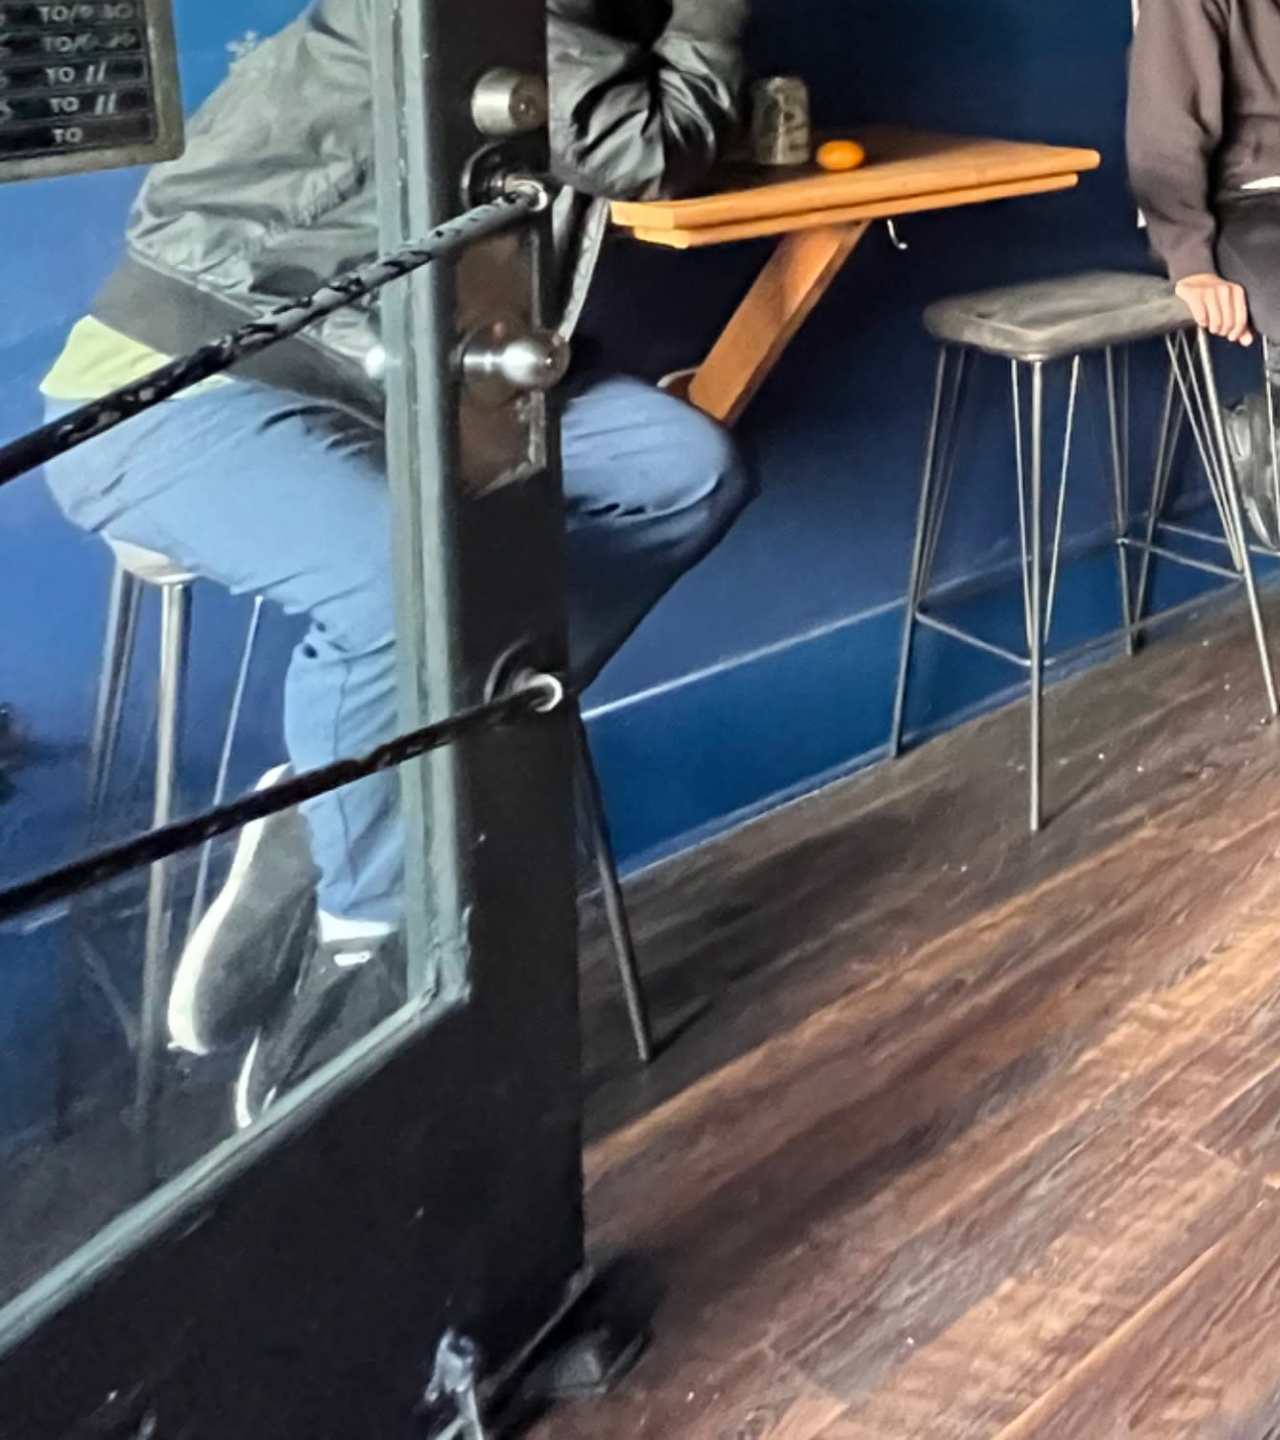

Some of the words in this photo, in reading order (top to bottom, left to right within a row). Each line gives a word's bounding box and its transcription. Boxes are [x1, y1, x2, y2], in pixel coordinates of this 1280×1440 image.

[46, 66, 76, 84] TO
[50, 97, 80, 112] TO
[52, 127, 83, 143] TO
